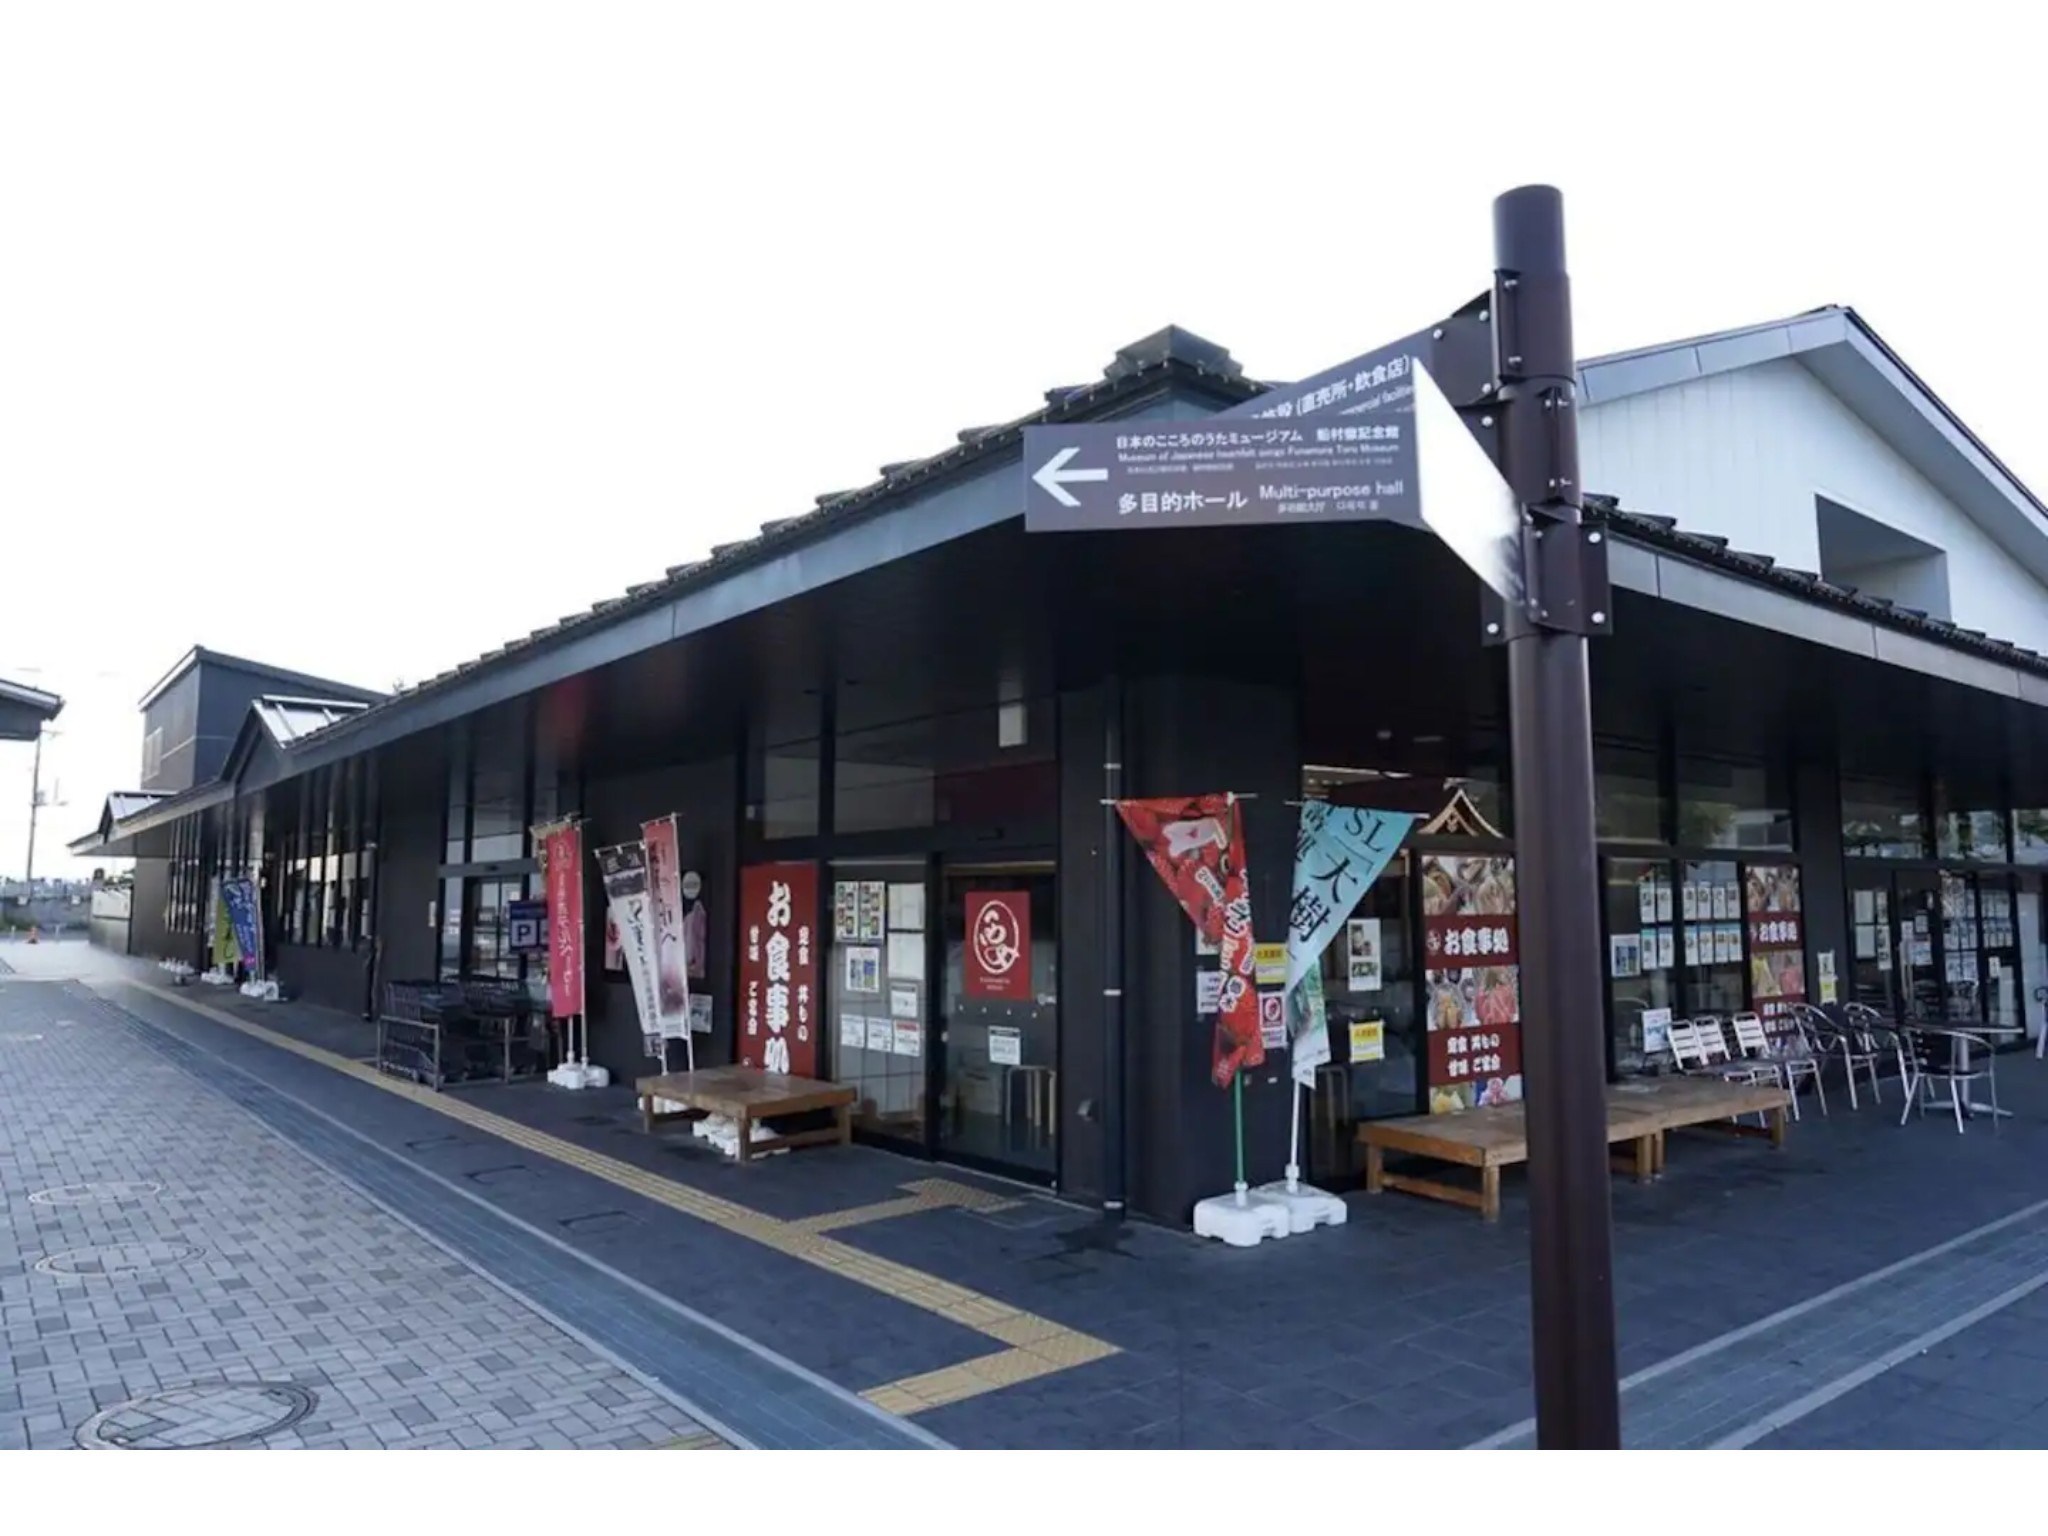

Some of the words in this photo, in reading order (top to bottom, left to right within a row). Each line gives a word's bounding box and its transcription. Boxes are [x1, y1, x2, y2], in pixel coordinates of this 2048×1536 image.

[1117, 429, 1303, 449] 日本のこころのうたミュージアム
[1259, 484, 1371, 500] Multi-purpose
[1375, 480, 1403, 496] hall
[1118, 489, 1249, 515] 多目的ホール
[518, 925, 531, 941] P
[1444, 926, 1510, 956] お食事処
